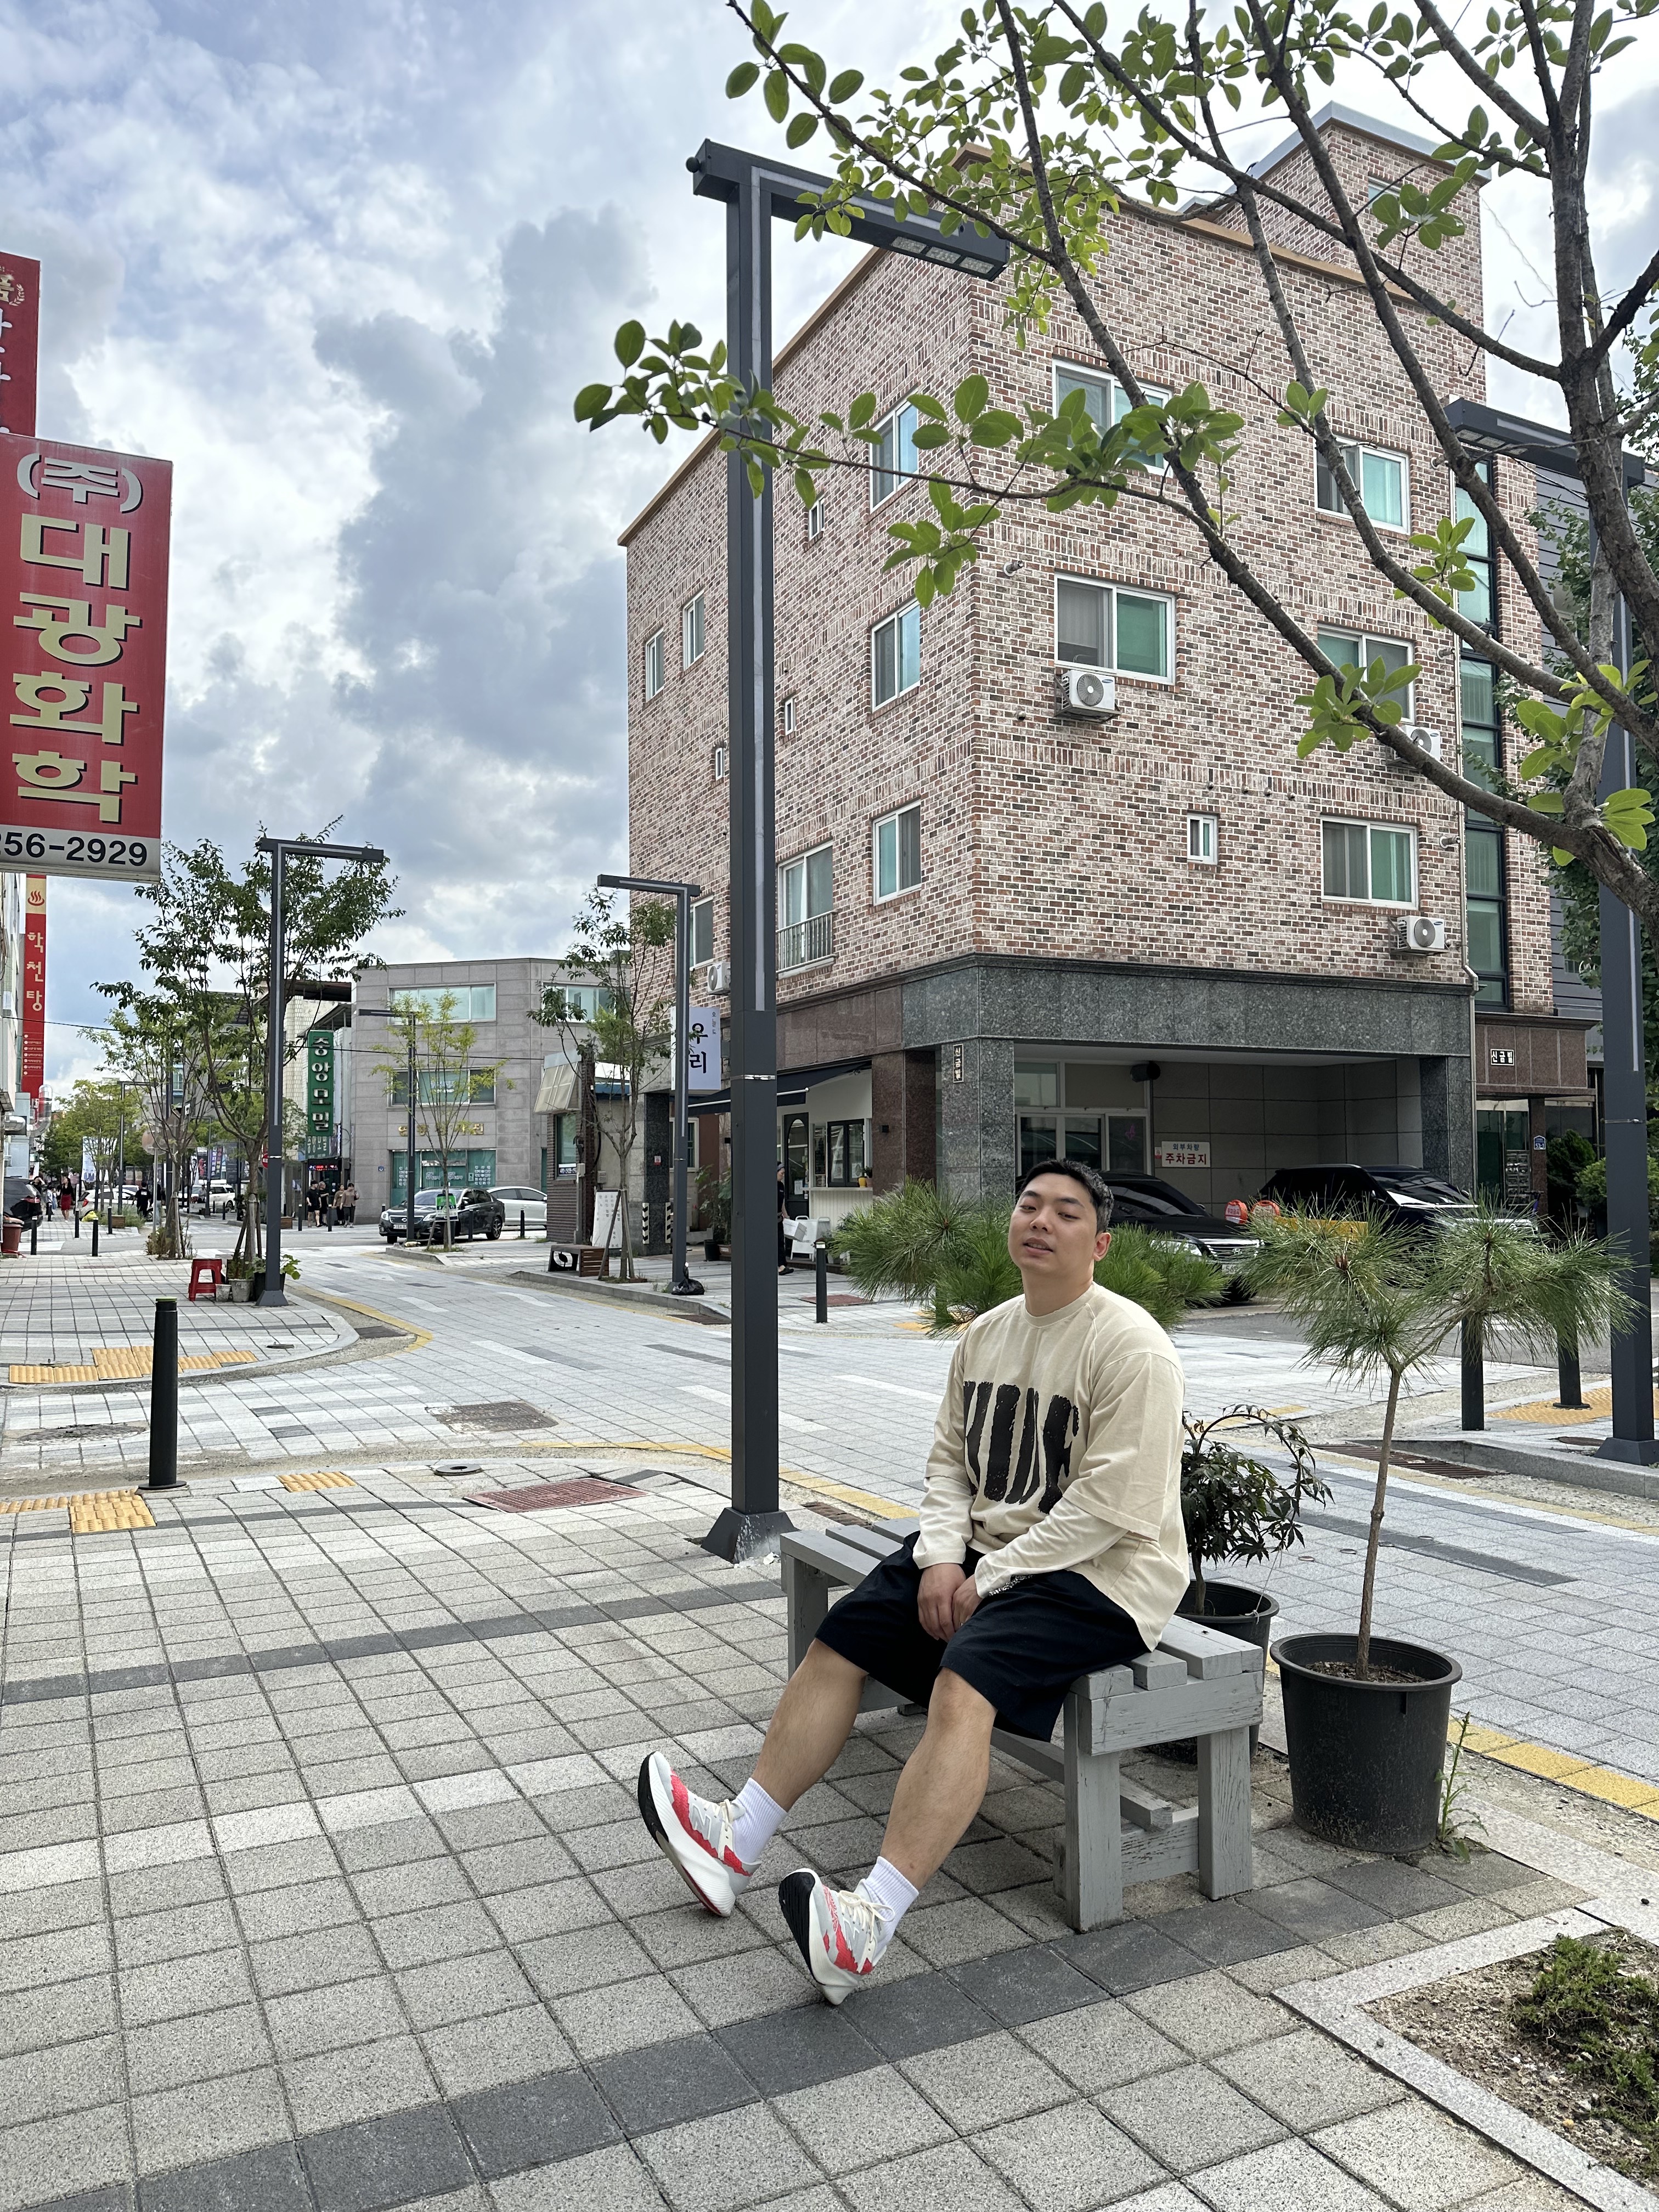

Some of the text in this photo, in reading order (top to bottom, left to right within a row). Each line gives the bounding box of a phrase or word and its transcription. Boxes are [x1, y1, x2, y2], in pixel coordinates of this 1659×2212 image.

[0, 832, 148, 867] 56-2929
[26, 932, 44, 1012] 학천탕
[689, 1023, 709, 1074] 우리
[311, 1036, 331, 1131] 중앙모밀
[1166, 1153, 1206, 1165] 주차금지
